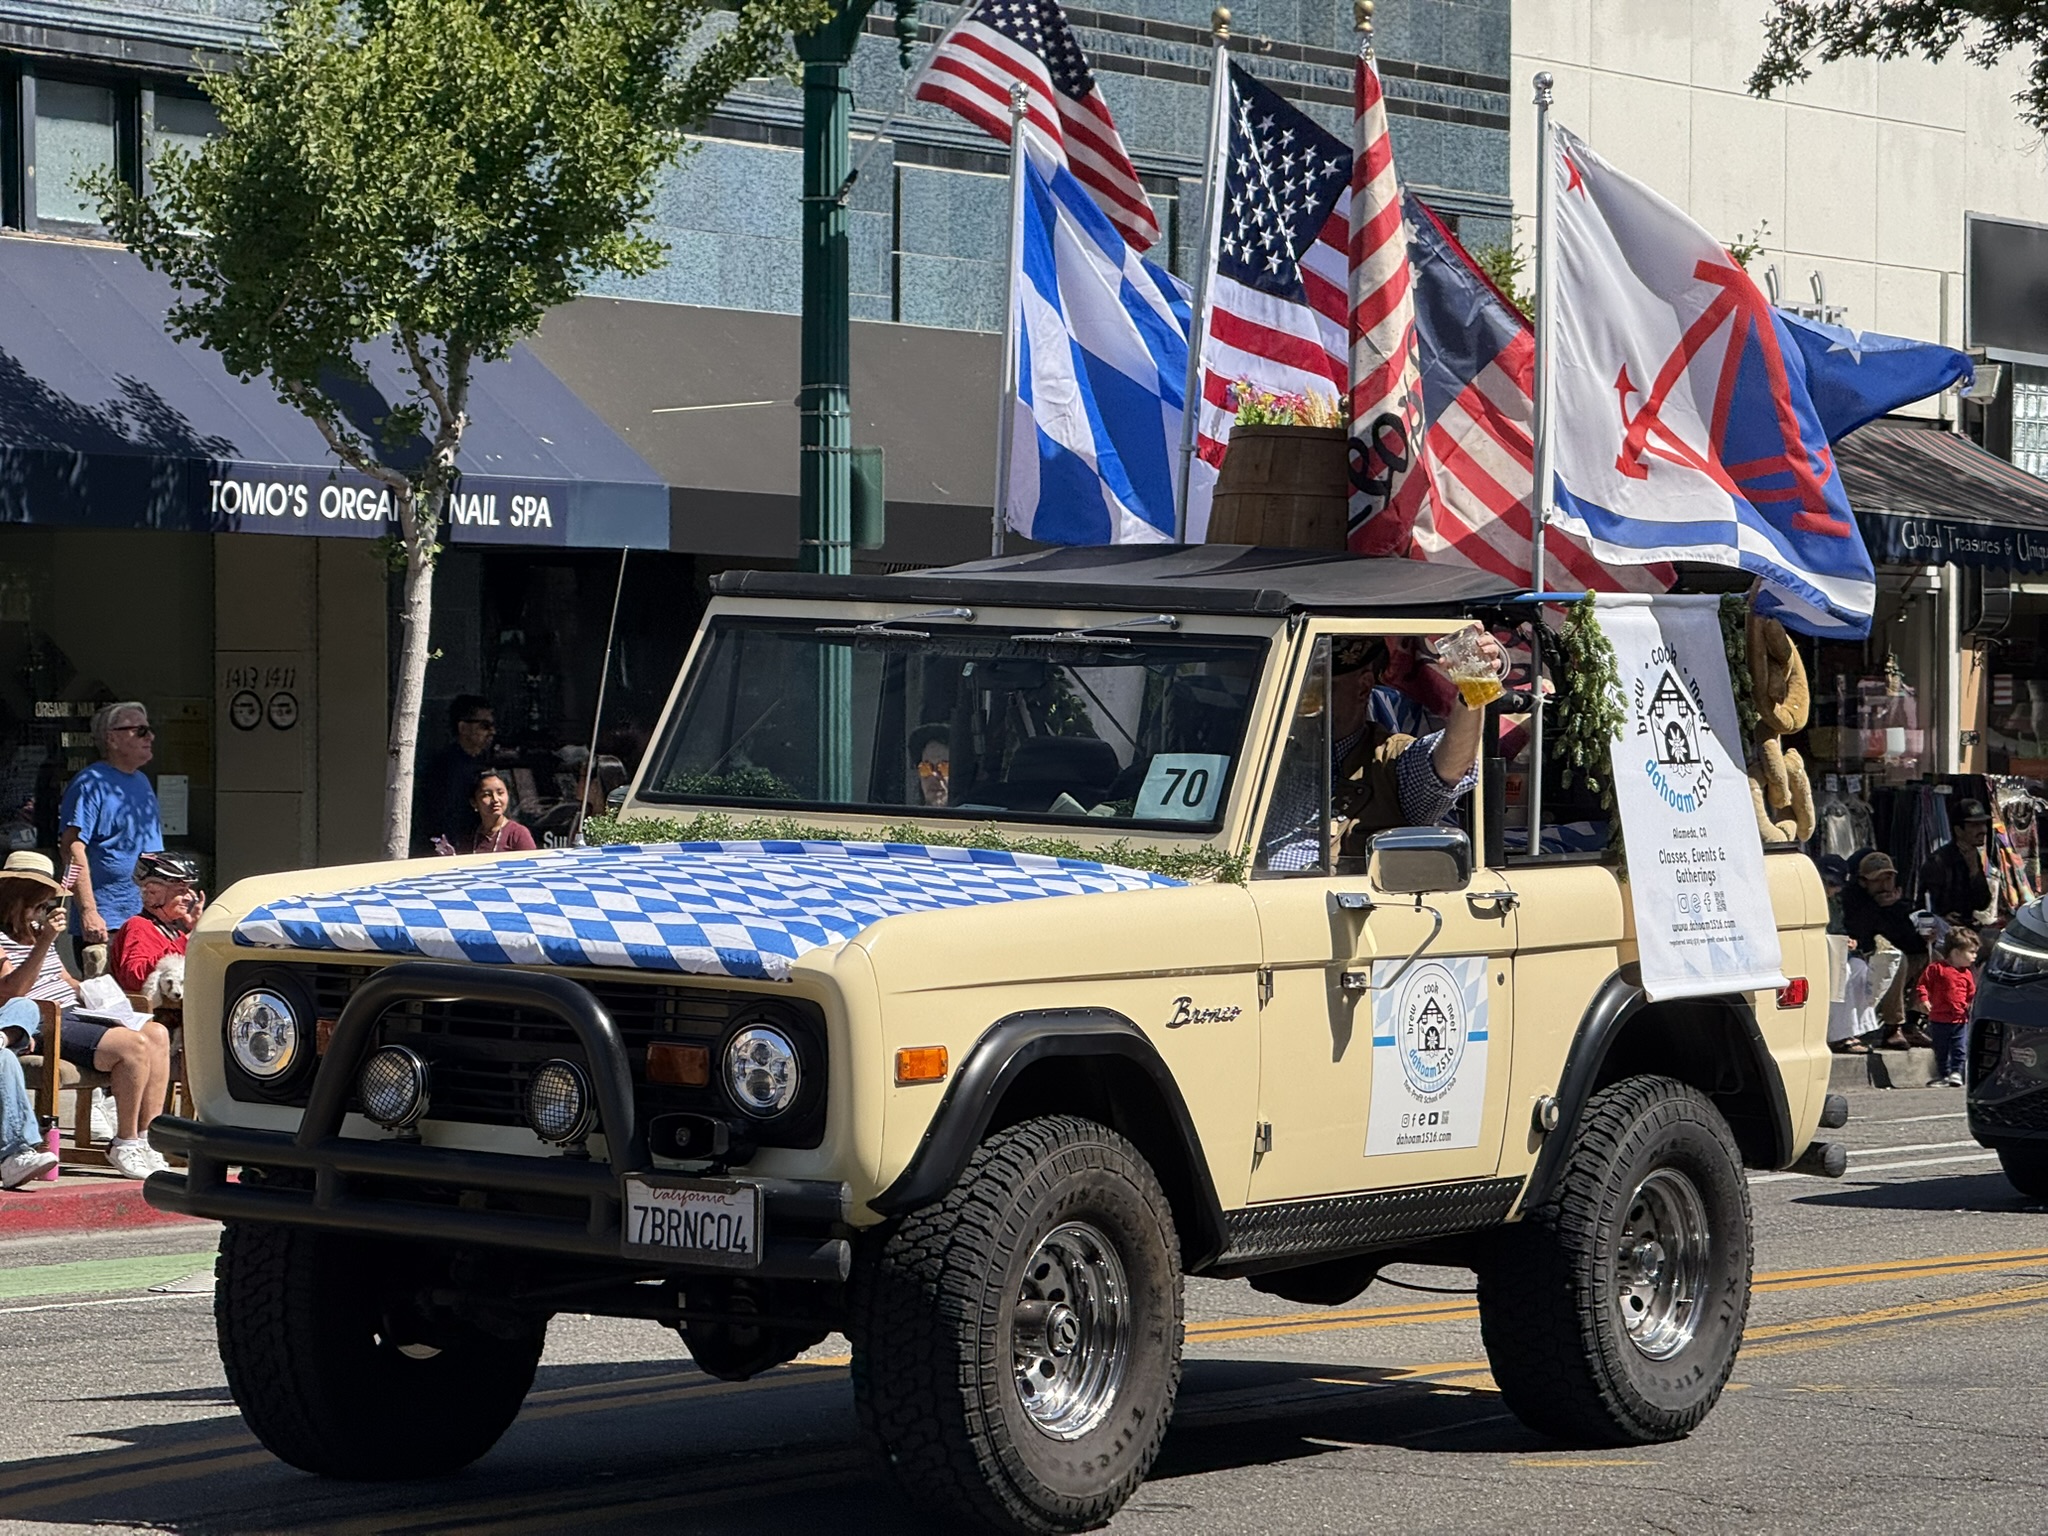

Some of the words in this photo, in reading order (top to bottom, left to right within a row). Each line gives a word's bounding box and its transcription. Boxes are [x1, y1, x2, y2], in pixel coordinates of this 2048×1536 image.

[209, 480, 308, 517] TOMO'S
[320, 485, 416, 523] ORGA
[448, 493, 500, 526] NAIL
[510, 495, 553, 528] SPA
[1901, 520, 1942, 550] Global
[1943, 525, 2001, 554] Treasures
[1634, 678, 1649, 736] brew
[1651, 642, 1677, 666] cook
[1689, 677, 1712, 735] meet
[1159, 767, 1209, 808] 70
[1659, 848, 1690, 865] Classes,
[1692, 847, 1717, 863] Events
[1718, 846, 1726, 861] &
[1676, 867, 1717, 886] Gatherings
[1165, 996, 1242, 1029] Bronco
[1407, 1003, 1417, 1035] brew
[1423, 982, 1439, 994] cook
[1447, 1003, 1457, 1032] meet
[652, 1188, 734, 1207] California
